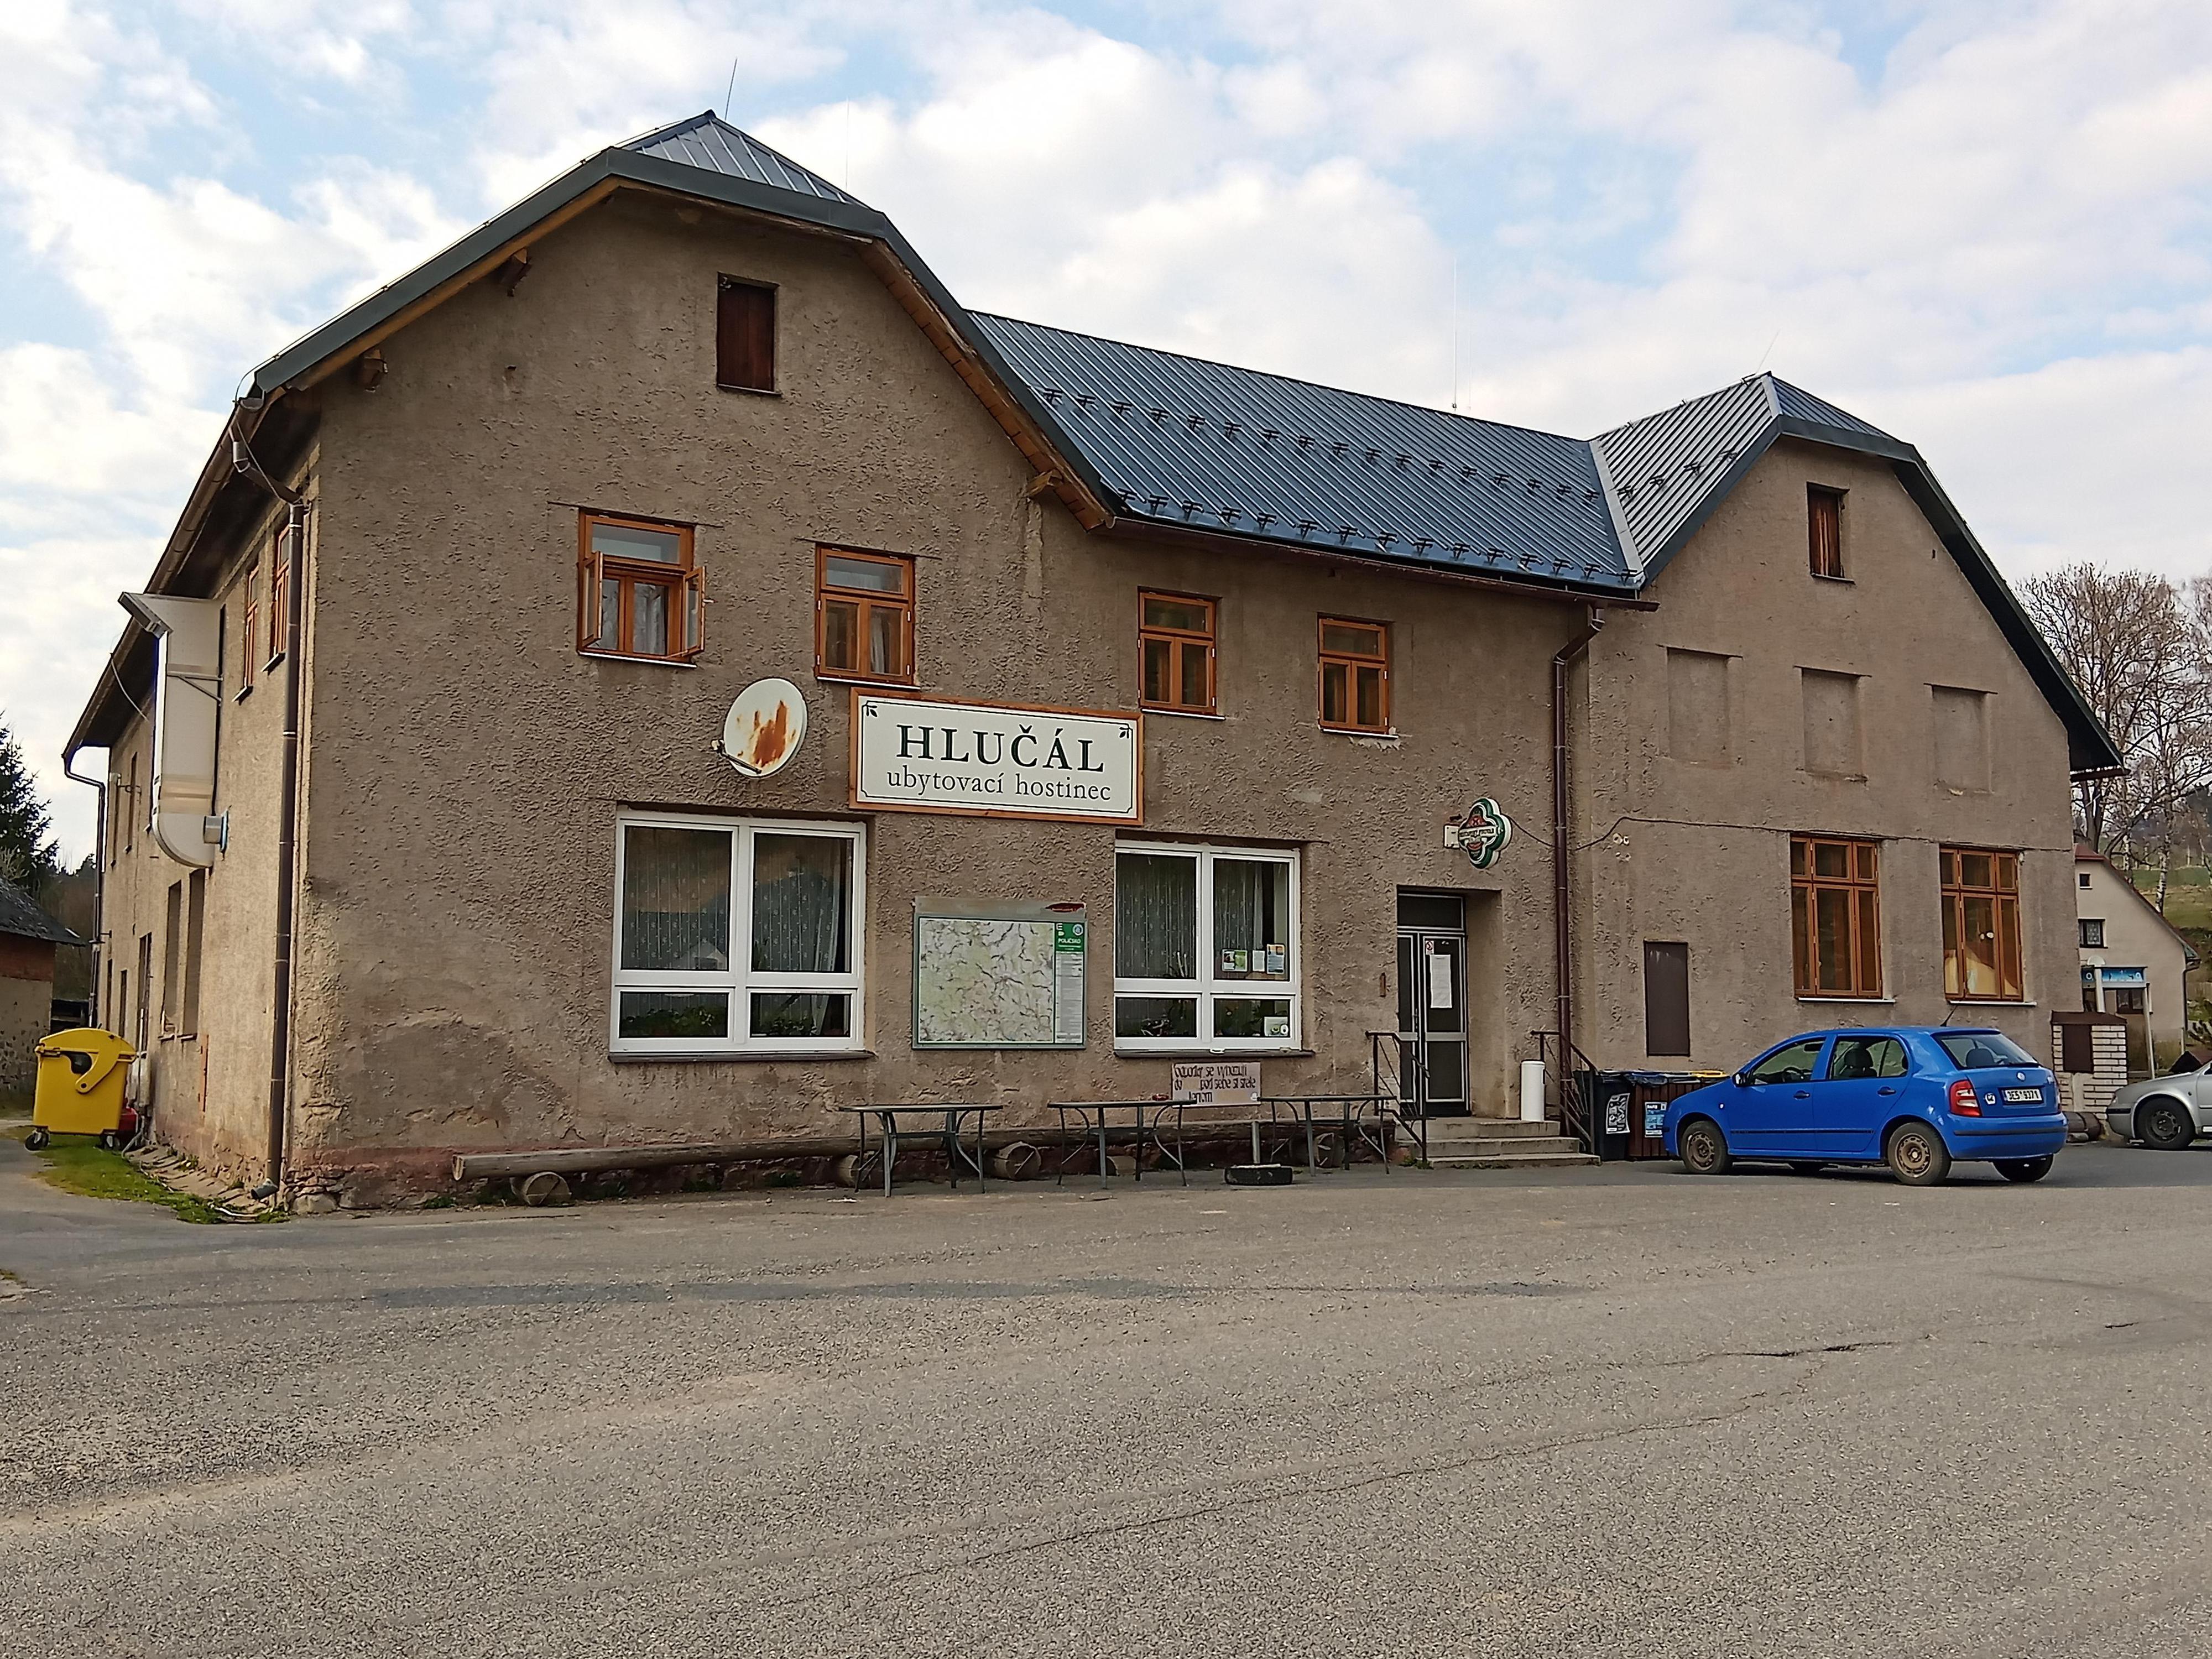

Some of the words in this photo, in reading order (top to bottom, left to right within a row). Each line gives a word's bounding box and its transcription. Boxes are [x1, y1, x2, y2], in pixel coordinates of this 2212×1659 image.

[896, 724, 1105, 773] HLUČÁL
[886, 765, 1004, 795] ubytovací
[1015, 774, 1112, 800] hostinec
